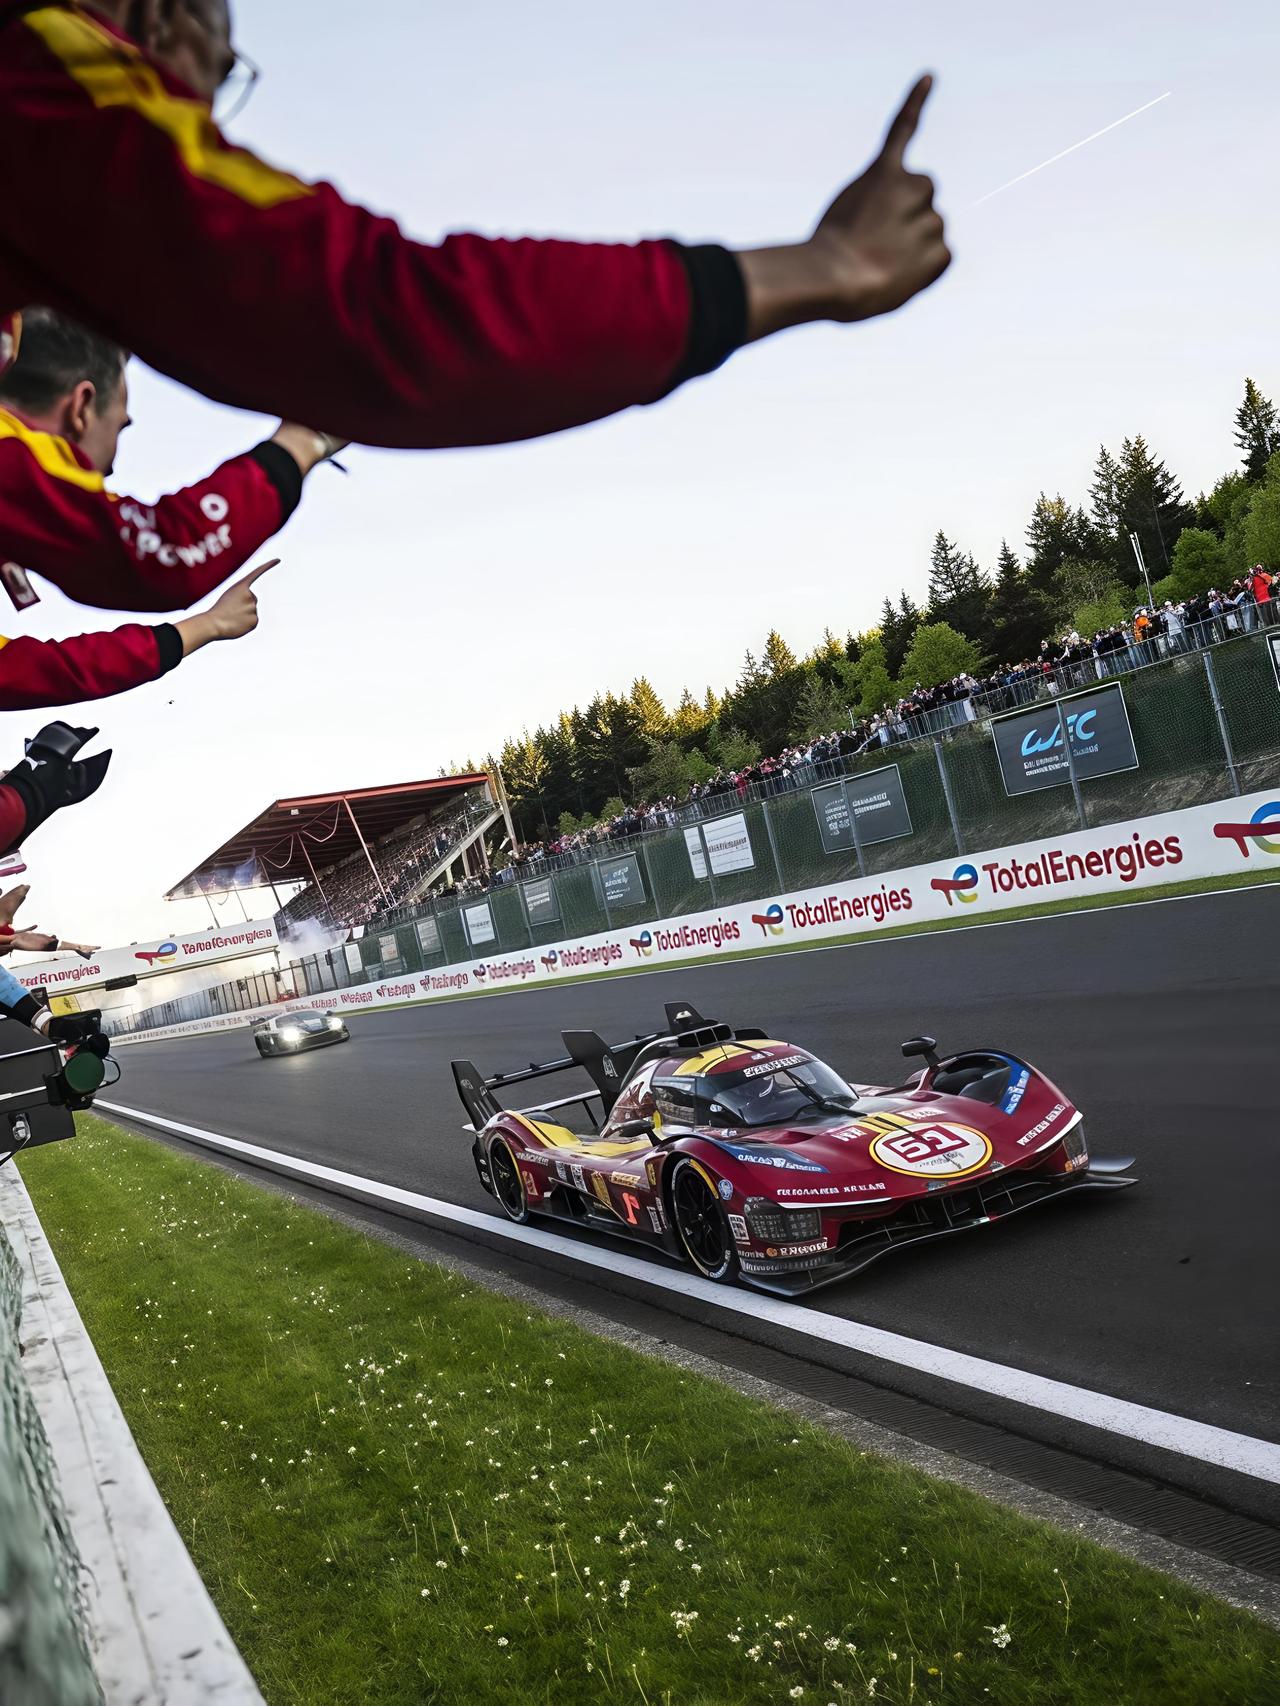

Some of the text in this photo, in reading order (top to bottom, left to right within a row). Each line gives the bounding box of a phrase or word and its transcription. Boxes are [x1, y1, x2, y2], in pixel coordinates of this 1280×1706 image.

[982, 833, 1183, 893] TotalEnergies
[786, 885, 912, 929] TotalEnergies
[653, 917, 740, 951] TotalEnergies
[558, 941, 622, 968] TotalEnergies
[889, 1129, 963, 1159] 51
